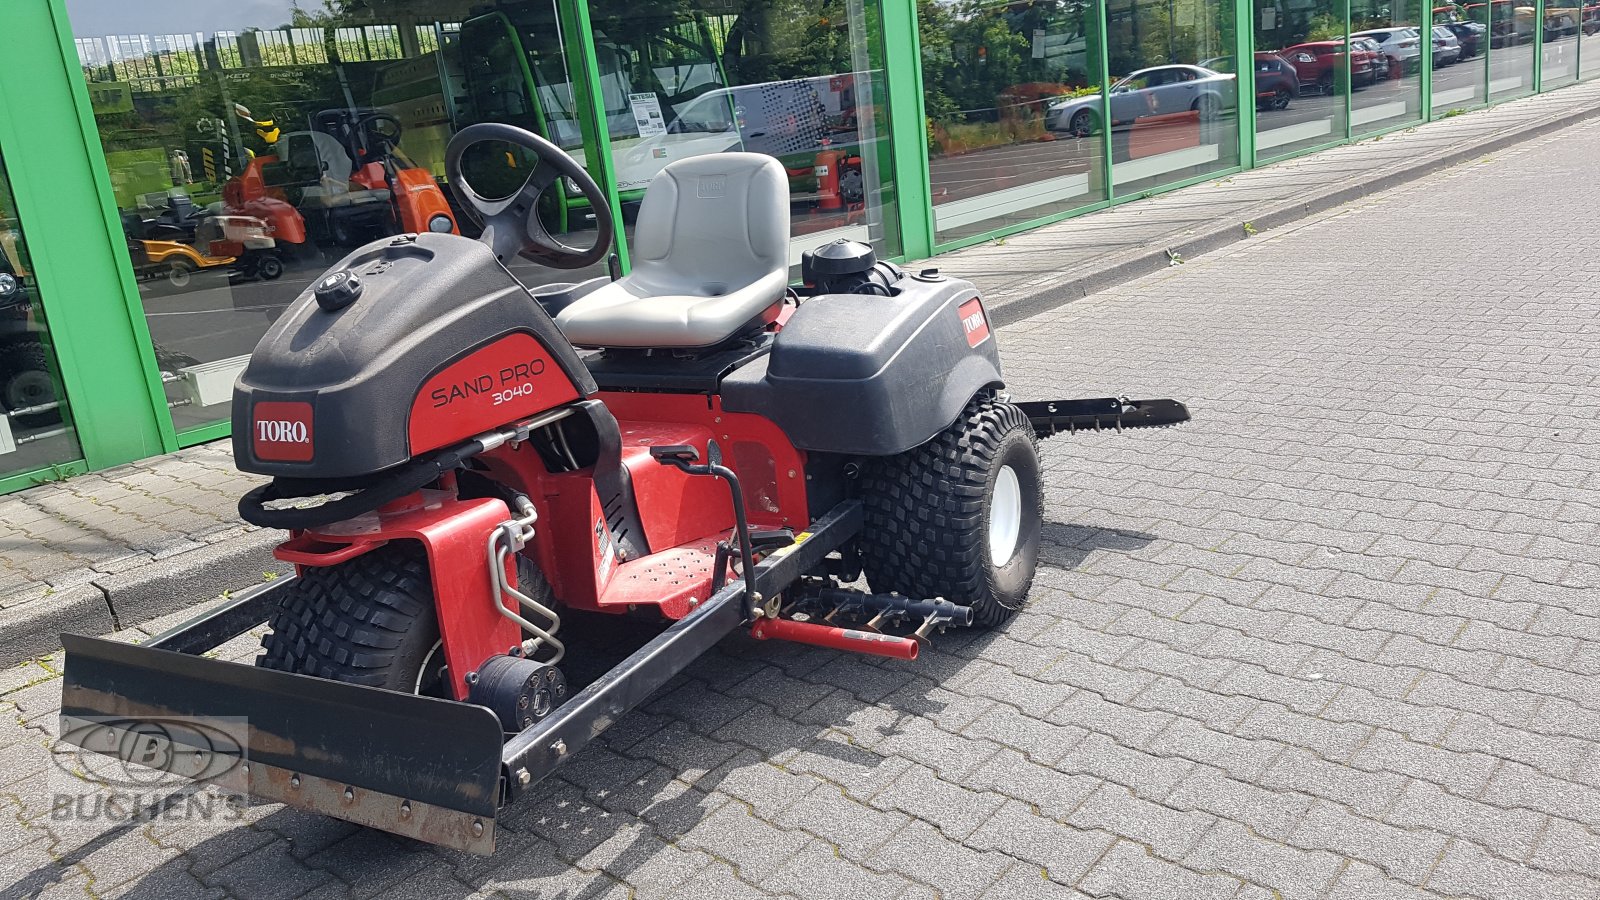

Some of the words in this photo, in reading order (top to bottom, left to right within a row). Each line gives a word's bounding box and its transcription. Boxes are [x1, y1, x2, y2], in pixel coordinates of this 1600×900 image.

[963, 311, 985, 334] TORO
[431, 374, 493, 409] SAND
[500, 358, 546, 384] PRO
[491, 382, 533, 406] 3040
[256, 419, 308, 445] TORO
